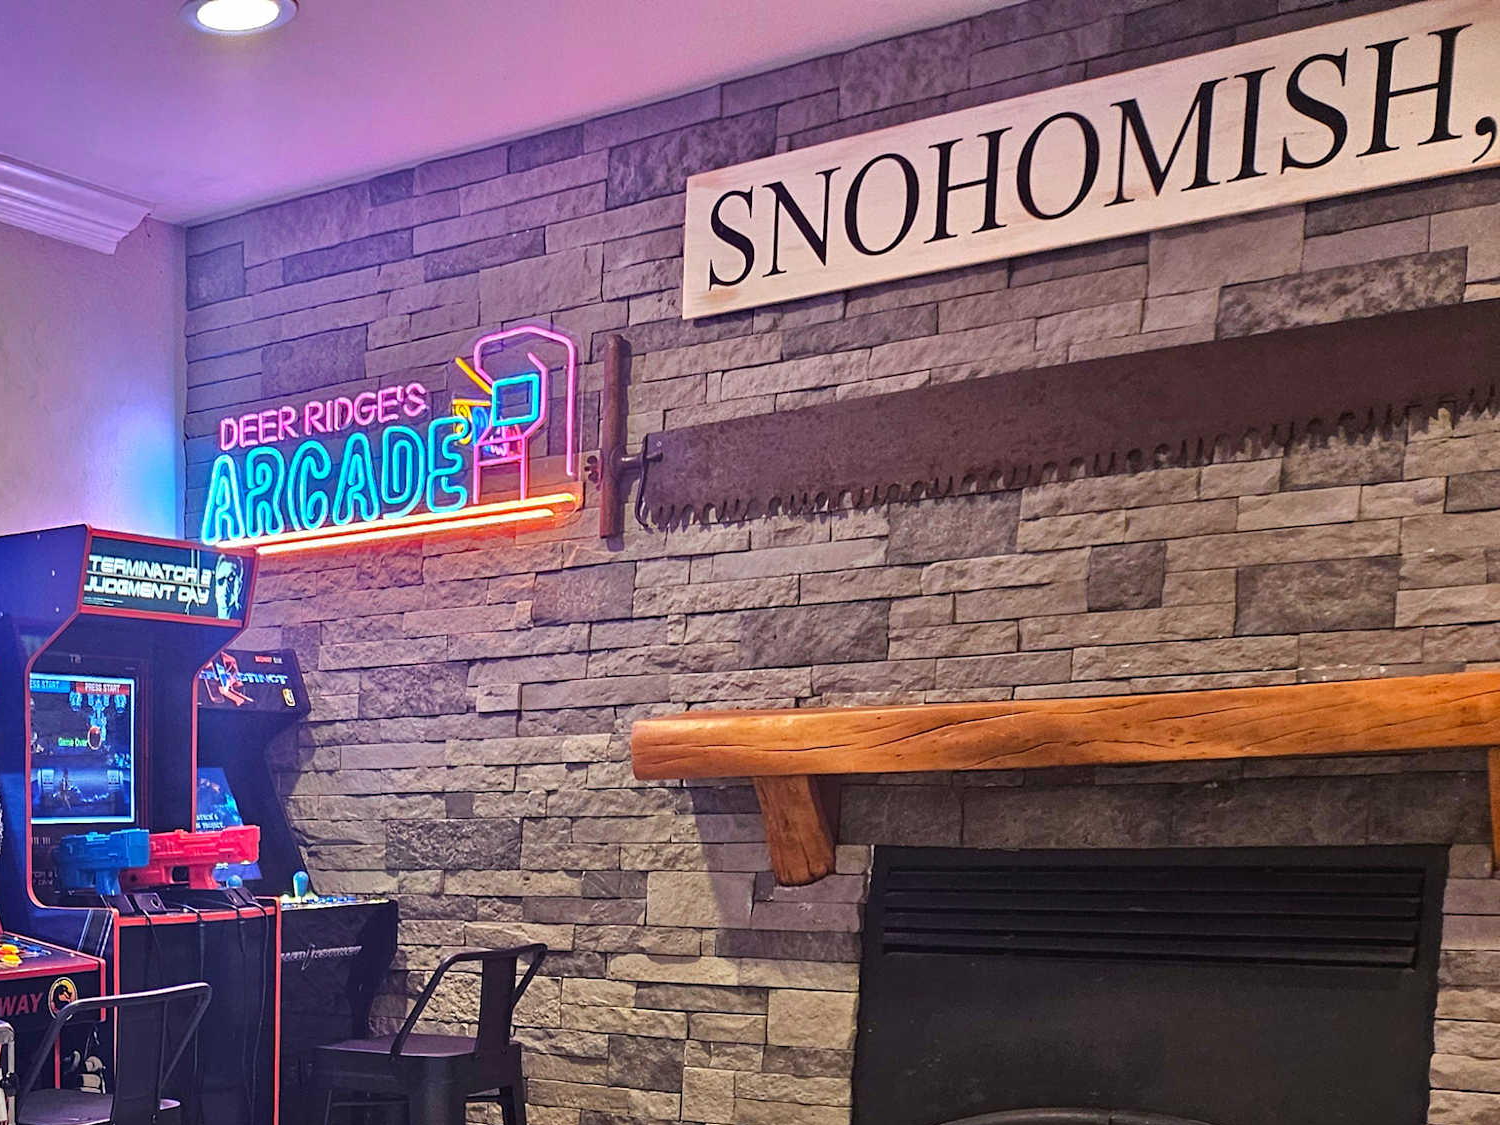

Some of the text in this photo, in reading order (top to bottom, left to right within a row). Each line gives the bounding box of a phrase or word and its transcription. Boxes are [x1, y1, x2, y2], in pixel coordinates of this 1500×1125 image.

[708, 23, 1499, 292] SNOHOMISH,
[220, 406, 297, 451] DEER
[202, 417, 471, 547] ARCADE
[88, 554, 212, 586] TERMINATOR 2
[83, 576, 210, 605] JUDGMENT DAY
[85, 682, 121, 693] PRESS START
